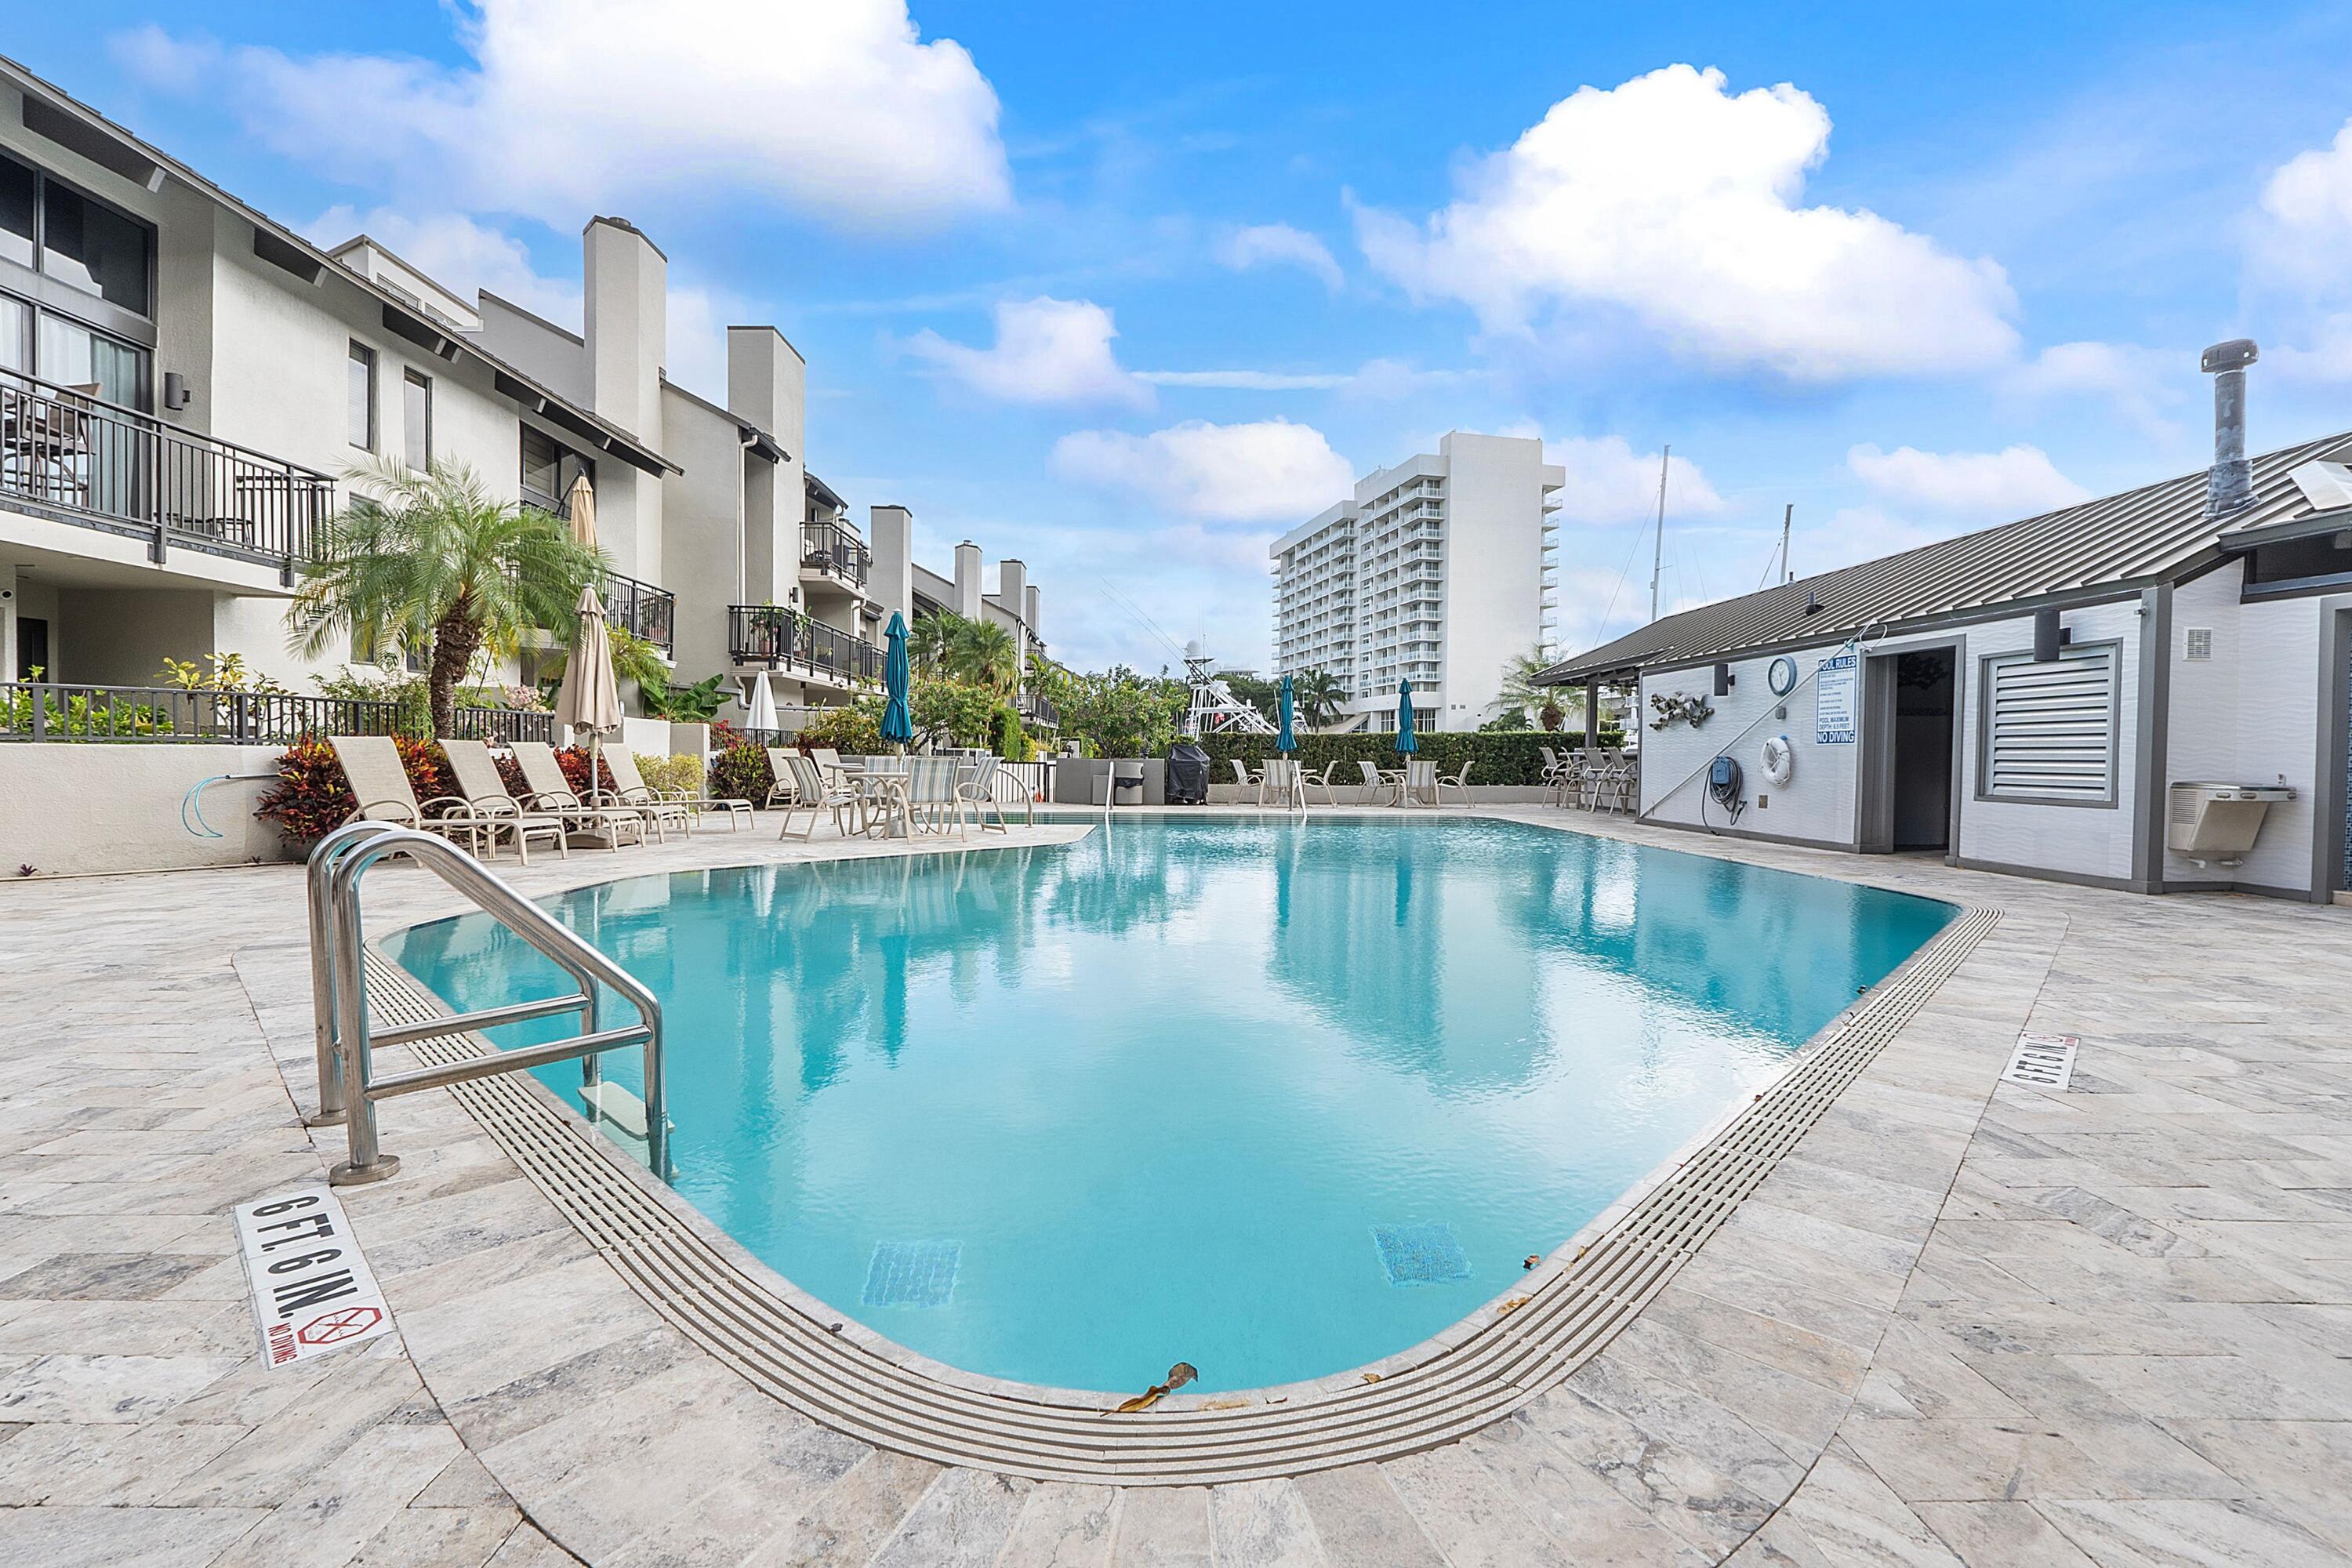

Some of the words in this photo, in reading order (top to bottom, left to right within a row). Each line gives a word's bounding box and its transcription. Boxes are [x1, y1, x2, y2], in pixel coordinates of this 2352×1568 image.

[1836, 656, 1856, 669] RULES
[1817, 732, 1828, 742] NO
[1829, 731, 1854, 742] DIVING
[252, 1196, 320, 1217] 6
[257, 1213, 335, 1252] FT.
[267, 1249, 343, 1274] 6
[273, 1269, 358, 1319] IN.
[268, 1322, 292, 1338] NO
[270, 1334, 298, 1365] DIVING
